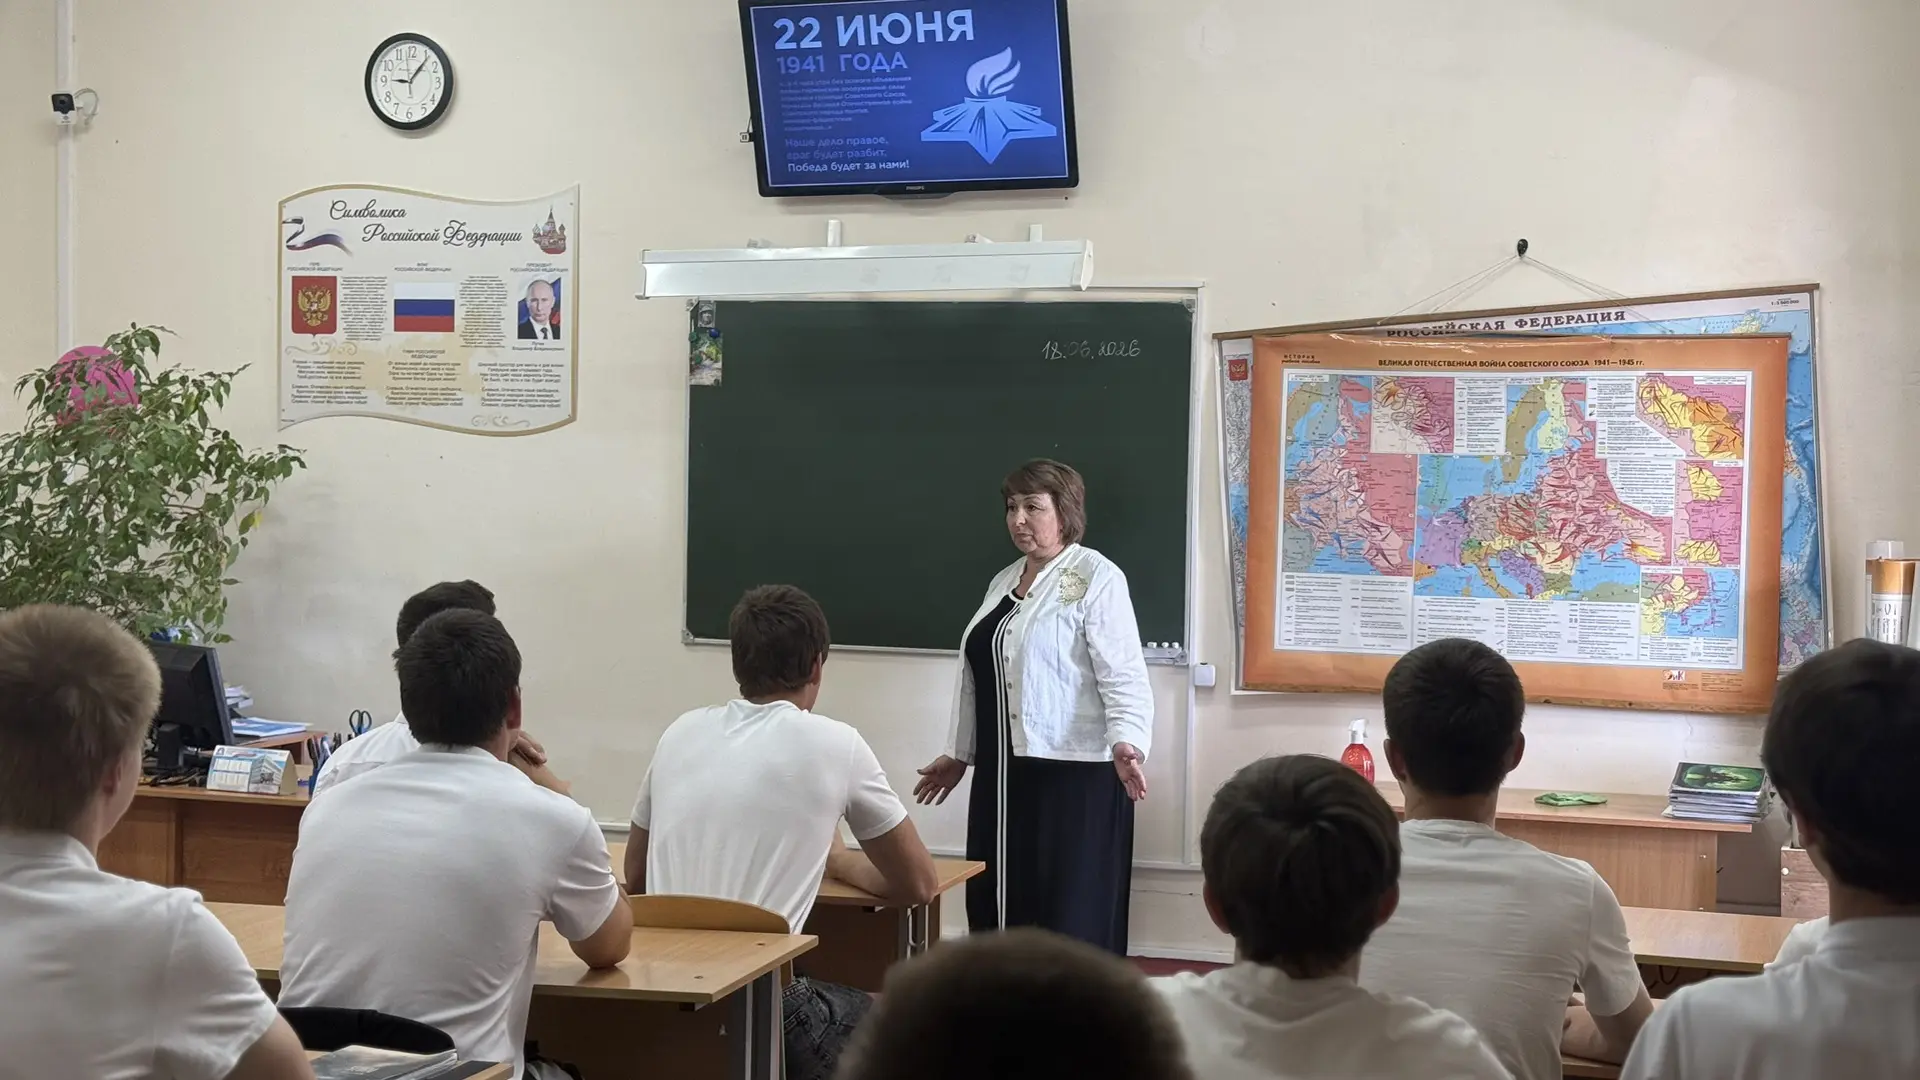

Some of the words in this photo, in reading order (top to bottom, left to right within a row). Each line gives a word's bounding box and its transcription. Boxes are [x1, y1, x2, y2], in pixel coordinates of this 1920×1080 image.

[773, 17, 822, 50] 22
[836, 9, 975, 47] ИЮНЯ
[396, 48, 402, 60] 11
[408, 46, 417, 58] 12
[384, 59, 394, 72] 10
[432, 61, 438, 73] 2
[776, 54, 825, 75] 1941
[838, 51, 908, 73] ГОДА
[380, 75, 387, 87] 9
[435, 77, 441, 90] 3
[384, 91, 391, 103] 8
[430, 93, 435, 105] 4
[393, 103, 399, 115] 7
[406, 107, 412, 119] 6
[421, 103, 427, 116] 5
[785, 138, 815, 147] Наше
[817, 138, 844, 147] дело
[786, 151, 812, 160] враг
[813, 149, 844, 160] будет
[788, 162, 828, 172] Победа
[830, 161, 861, 172] будет
[864, 162, 877, 170] за
[879, 159, 910, 169] нами!
[329, 199, 407, 220] Символика
[361, 223, 440, 242] Российской
[443, 219, 522, 247] Федерации
[1514, 310, 1626, 329] ФЕДЕРАЦИЯ
[1378, 359, 1413, 367] ВЕЛИКАЯ
[1414, 359, 1477, 368] ОТЕЧЕСТВЕННАЯ
[1479, 358, 1507, 368] ВОЙНА
[1508, 359, 1559, 368] СОВЕТСКОГО
[1560, 359, 1590, 367] СОЮЗА
